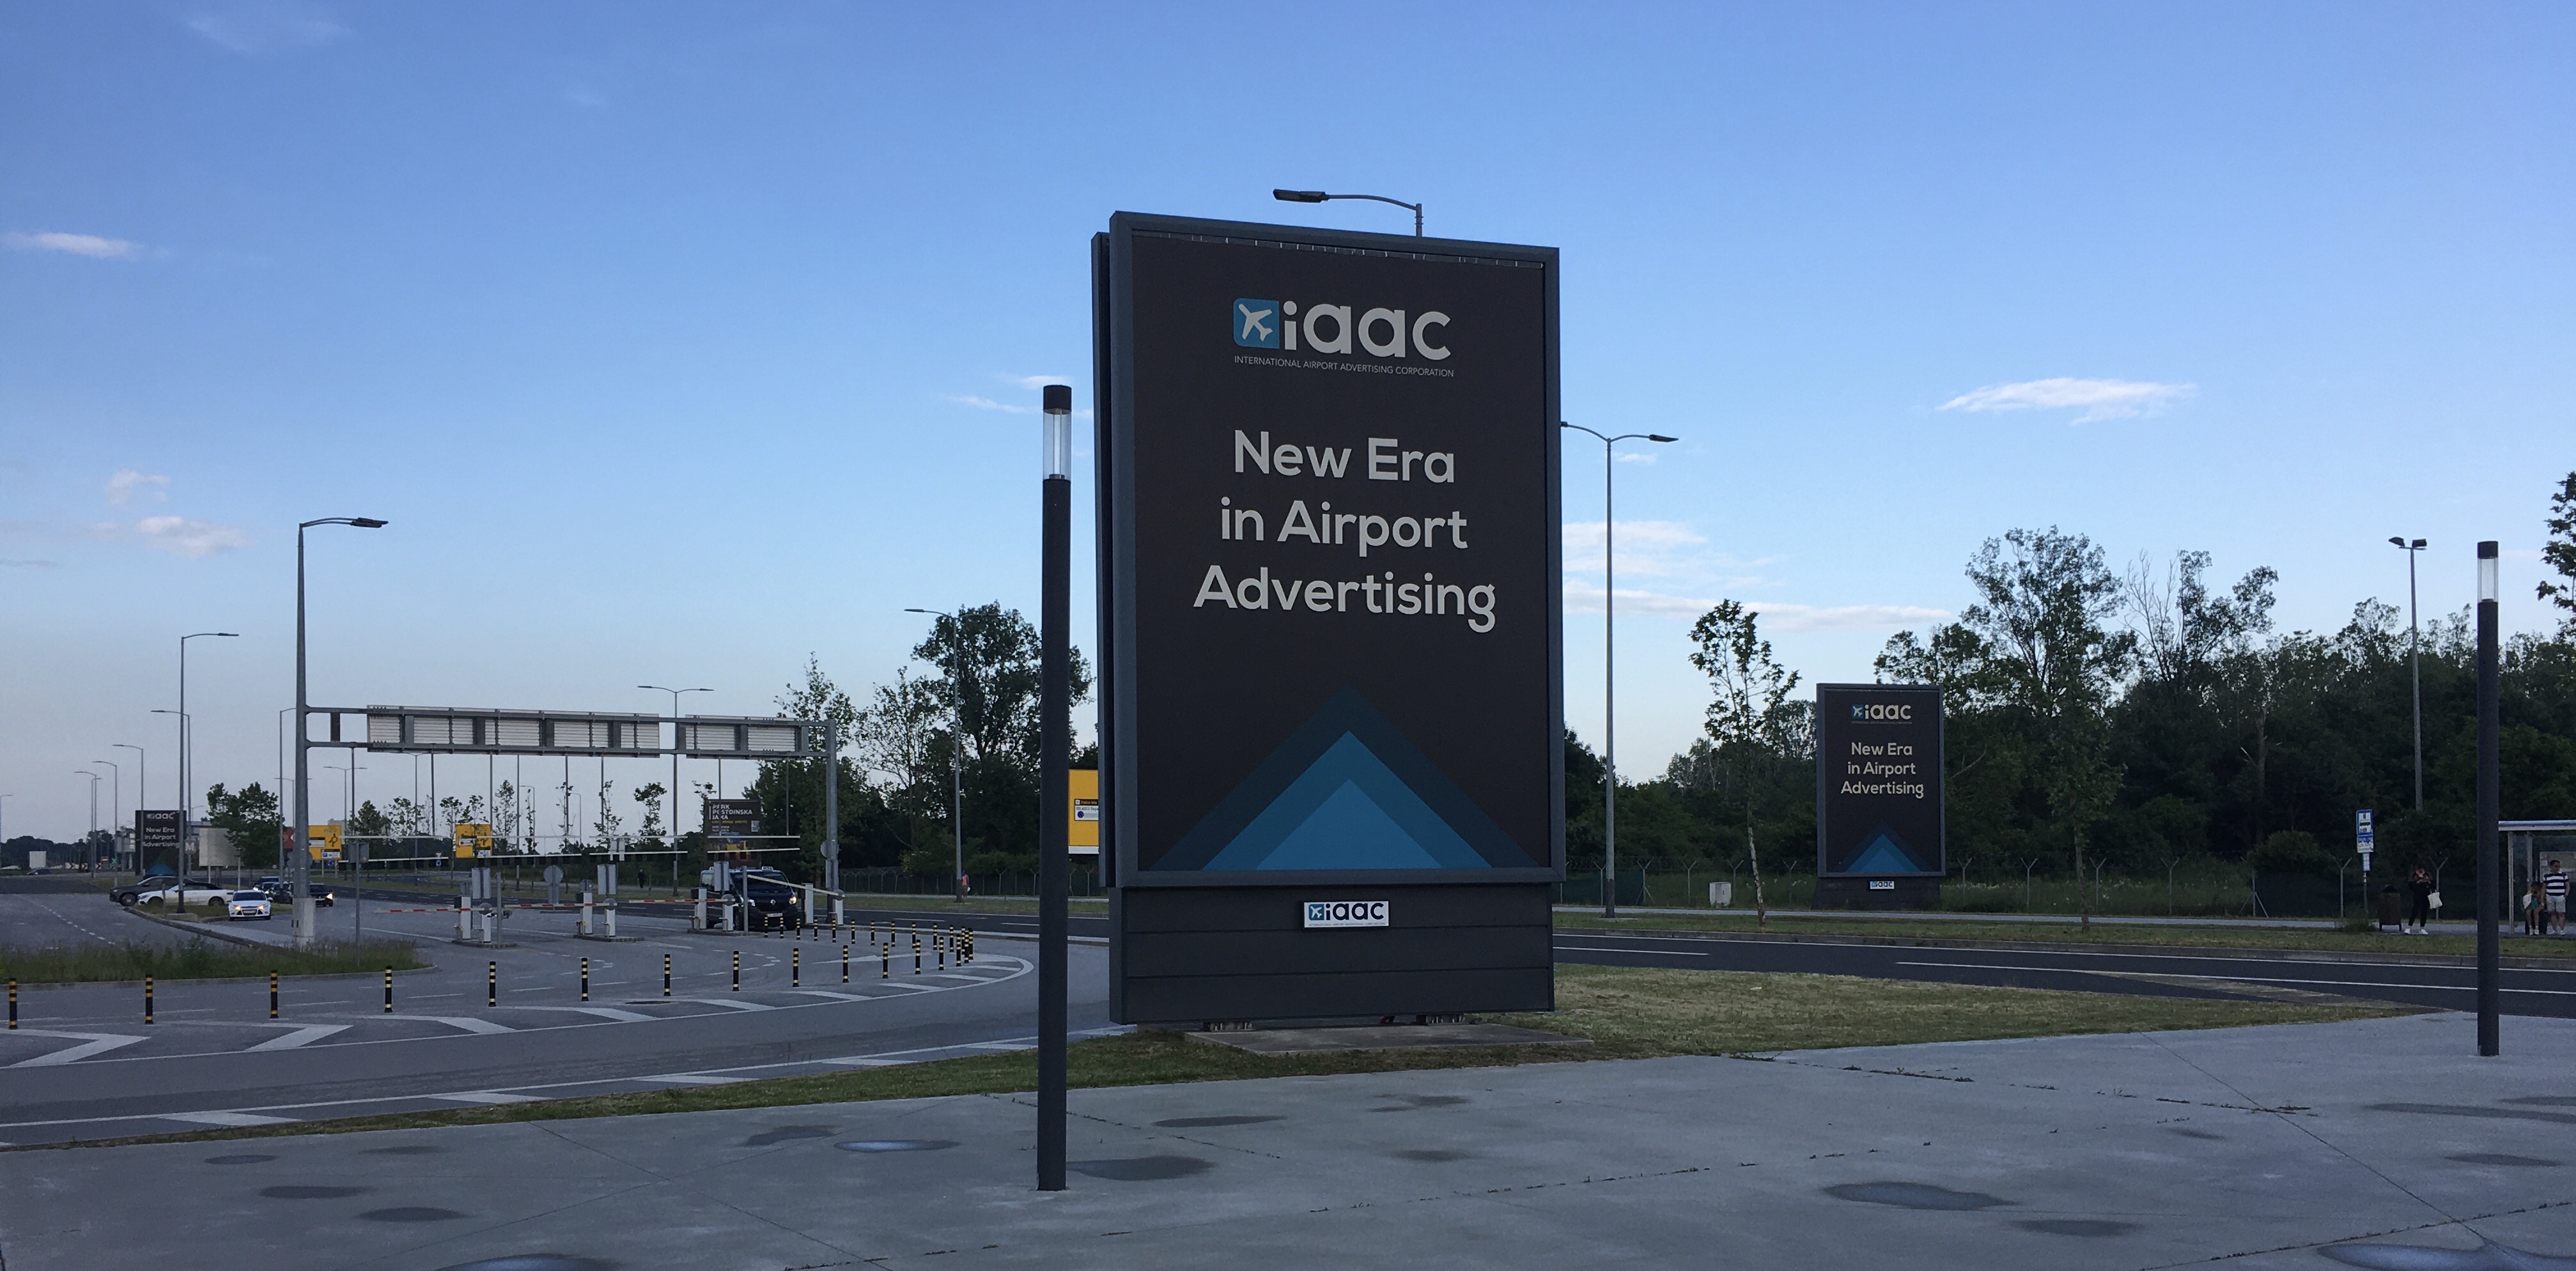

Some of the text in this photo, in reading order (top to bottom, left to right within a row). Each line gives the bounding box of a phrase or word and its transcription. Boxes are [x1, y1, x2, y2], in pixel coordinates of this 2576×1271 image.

[1283, 300, 1451, 362] iaac
[1234, 355, 1454, 378] INTERNATIONAL AIRPORT ADVERTISING CORPORATION
[1234, 430, 1454, 483] New Era
[1221, 497, 1468, 557] in Airport
[1193, 565, 1496, 633] Advertising
[1865, 704, 1911, 720] iaac
[1851, 743, 1913, 755] New Era
[1847, 762, 1916, 778] in Airport
[1840, 781, 1924, 799] Advertising
[1326, 902, 1385, 920] iaac
